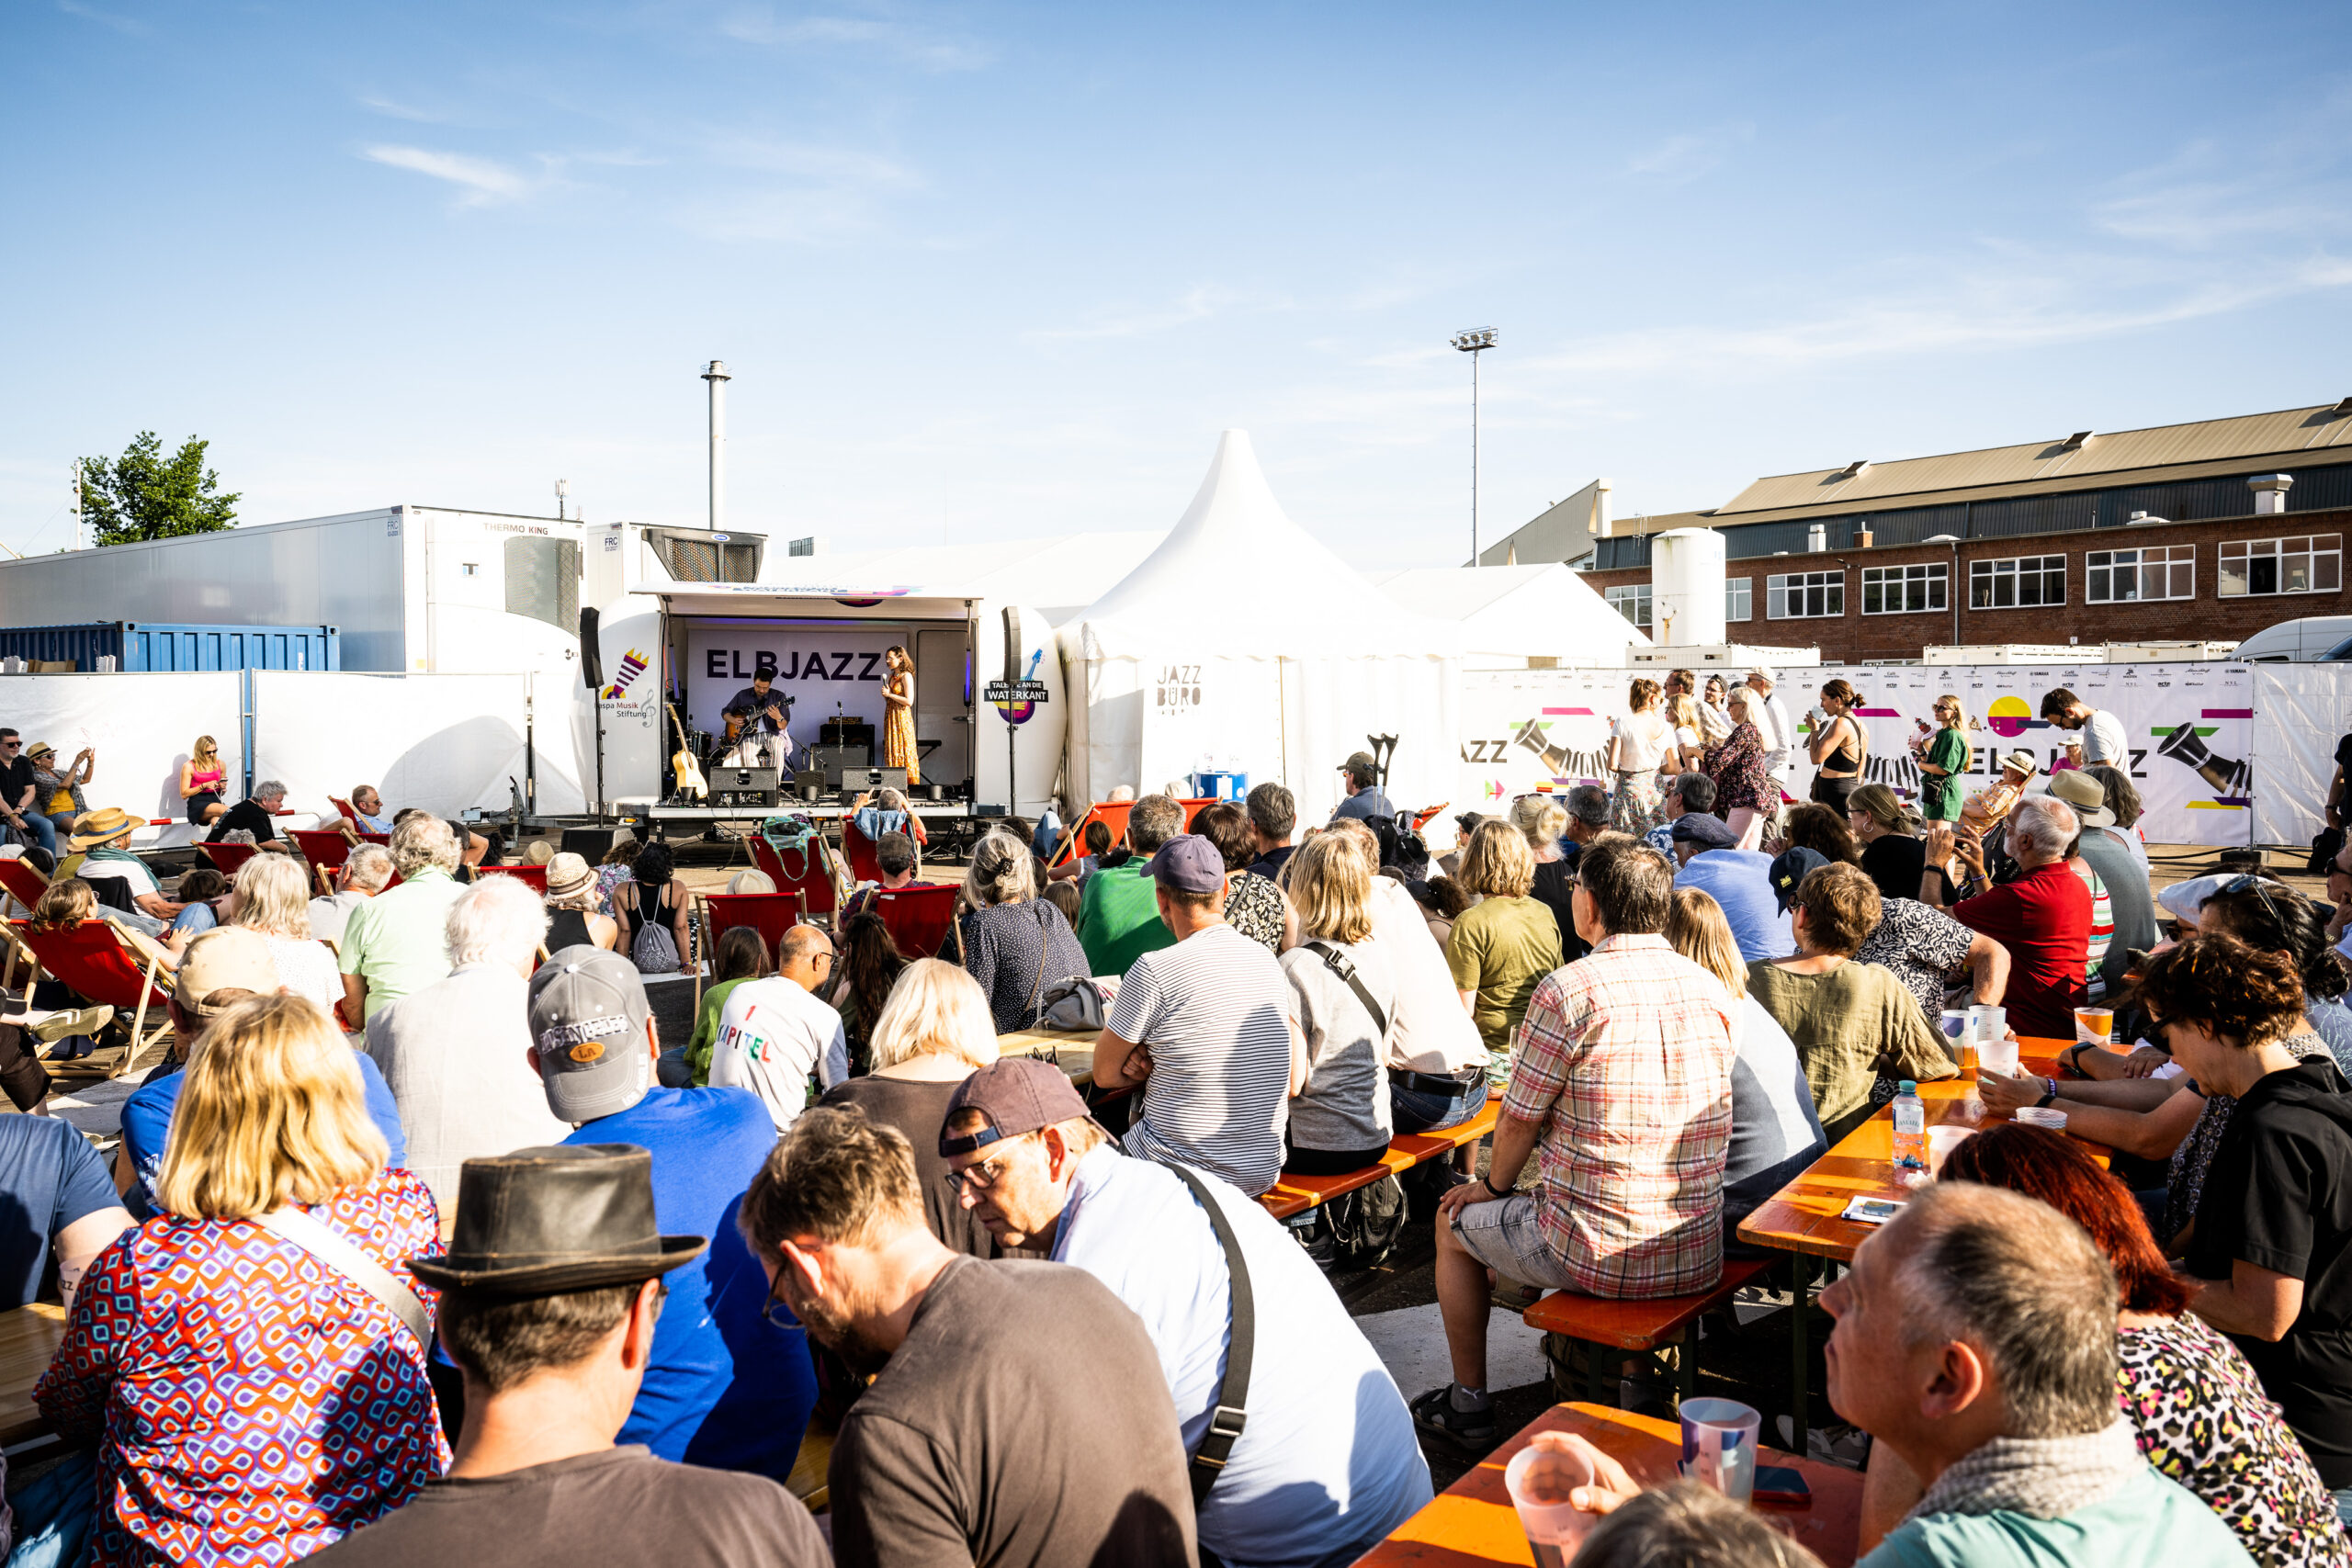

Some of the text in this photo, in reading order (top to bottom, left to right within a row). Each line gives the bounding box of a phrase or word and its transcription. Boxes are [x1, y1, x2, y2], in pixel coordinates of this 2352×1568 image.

[483, 522, 548, 536] THERMO KING
[605, 536, 618, 547] FRC
[707, 649, 881, 681] ELBJAZZ
[1157, 665, 1201, 684] JAZZ
[988, 690, 1046, 700] WATERKANT
[1157, 687, 1201, 706] BÜRO
[616, 710, 647, 718] Stiftung
[716, 1023, 771, 1064] KAPITEL
[578, 1047, 596, 1059] LA
